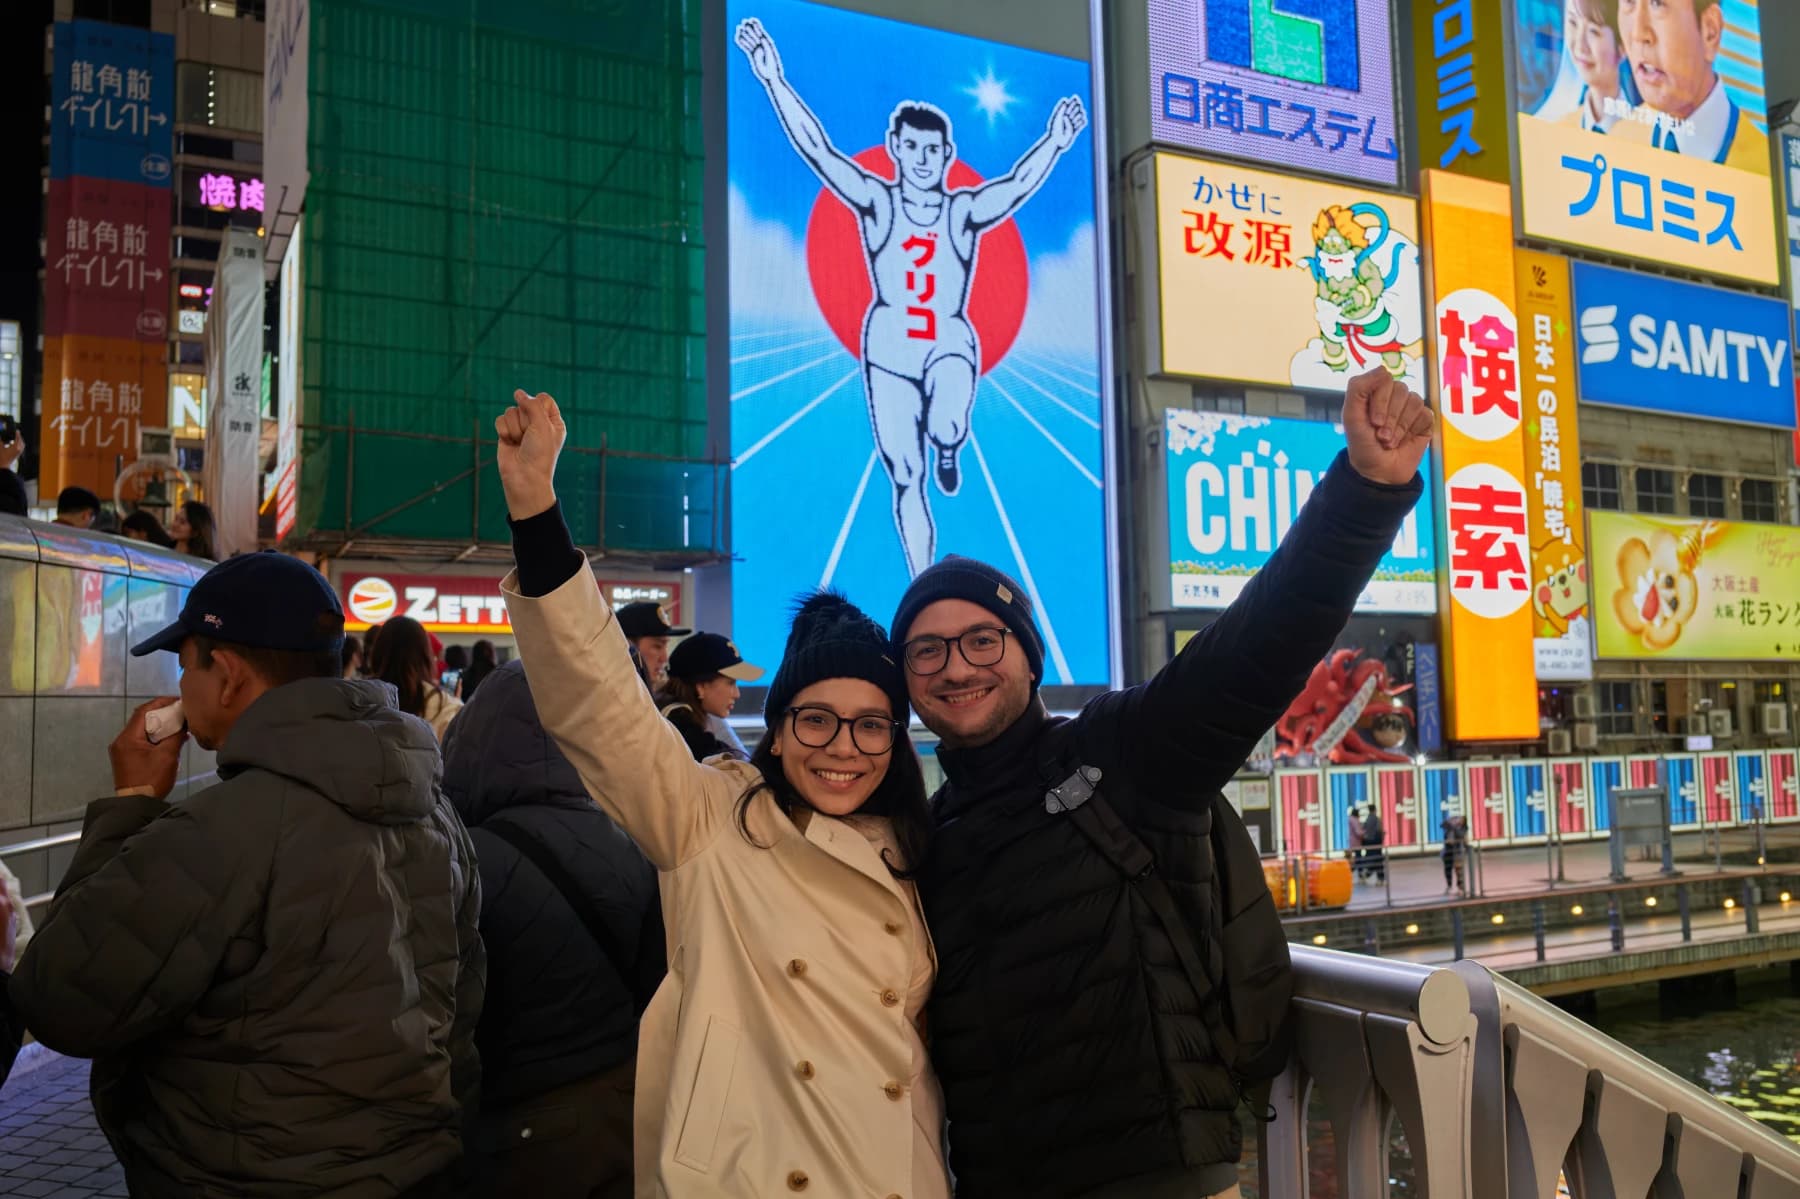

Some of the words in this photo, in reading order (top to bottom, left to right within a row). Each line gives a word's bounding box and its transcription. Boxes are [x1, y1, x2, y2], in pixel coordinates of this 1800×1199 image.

[71, 60, 152, 101] 龍角散
[1433, 0, 1482, 168] ロミス
[60, 96, 149, 136] ダイレクト
[1163, 72, 1398, 160] 日商エステム
[1561, 153, 1743, 251] プロミス
[66, 217, 149, 256] 龍角散
[1181, 210, 1292, 268] 改源
[55, 254, 145, 292] ダイレクト
[902, 232, 938, 340] グリコ
[1629, 314, 1787, 387] SAMTY
[61, 378, 143, 414] 龍角散
[405, 586, 506, 624] ZETT
